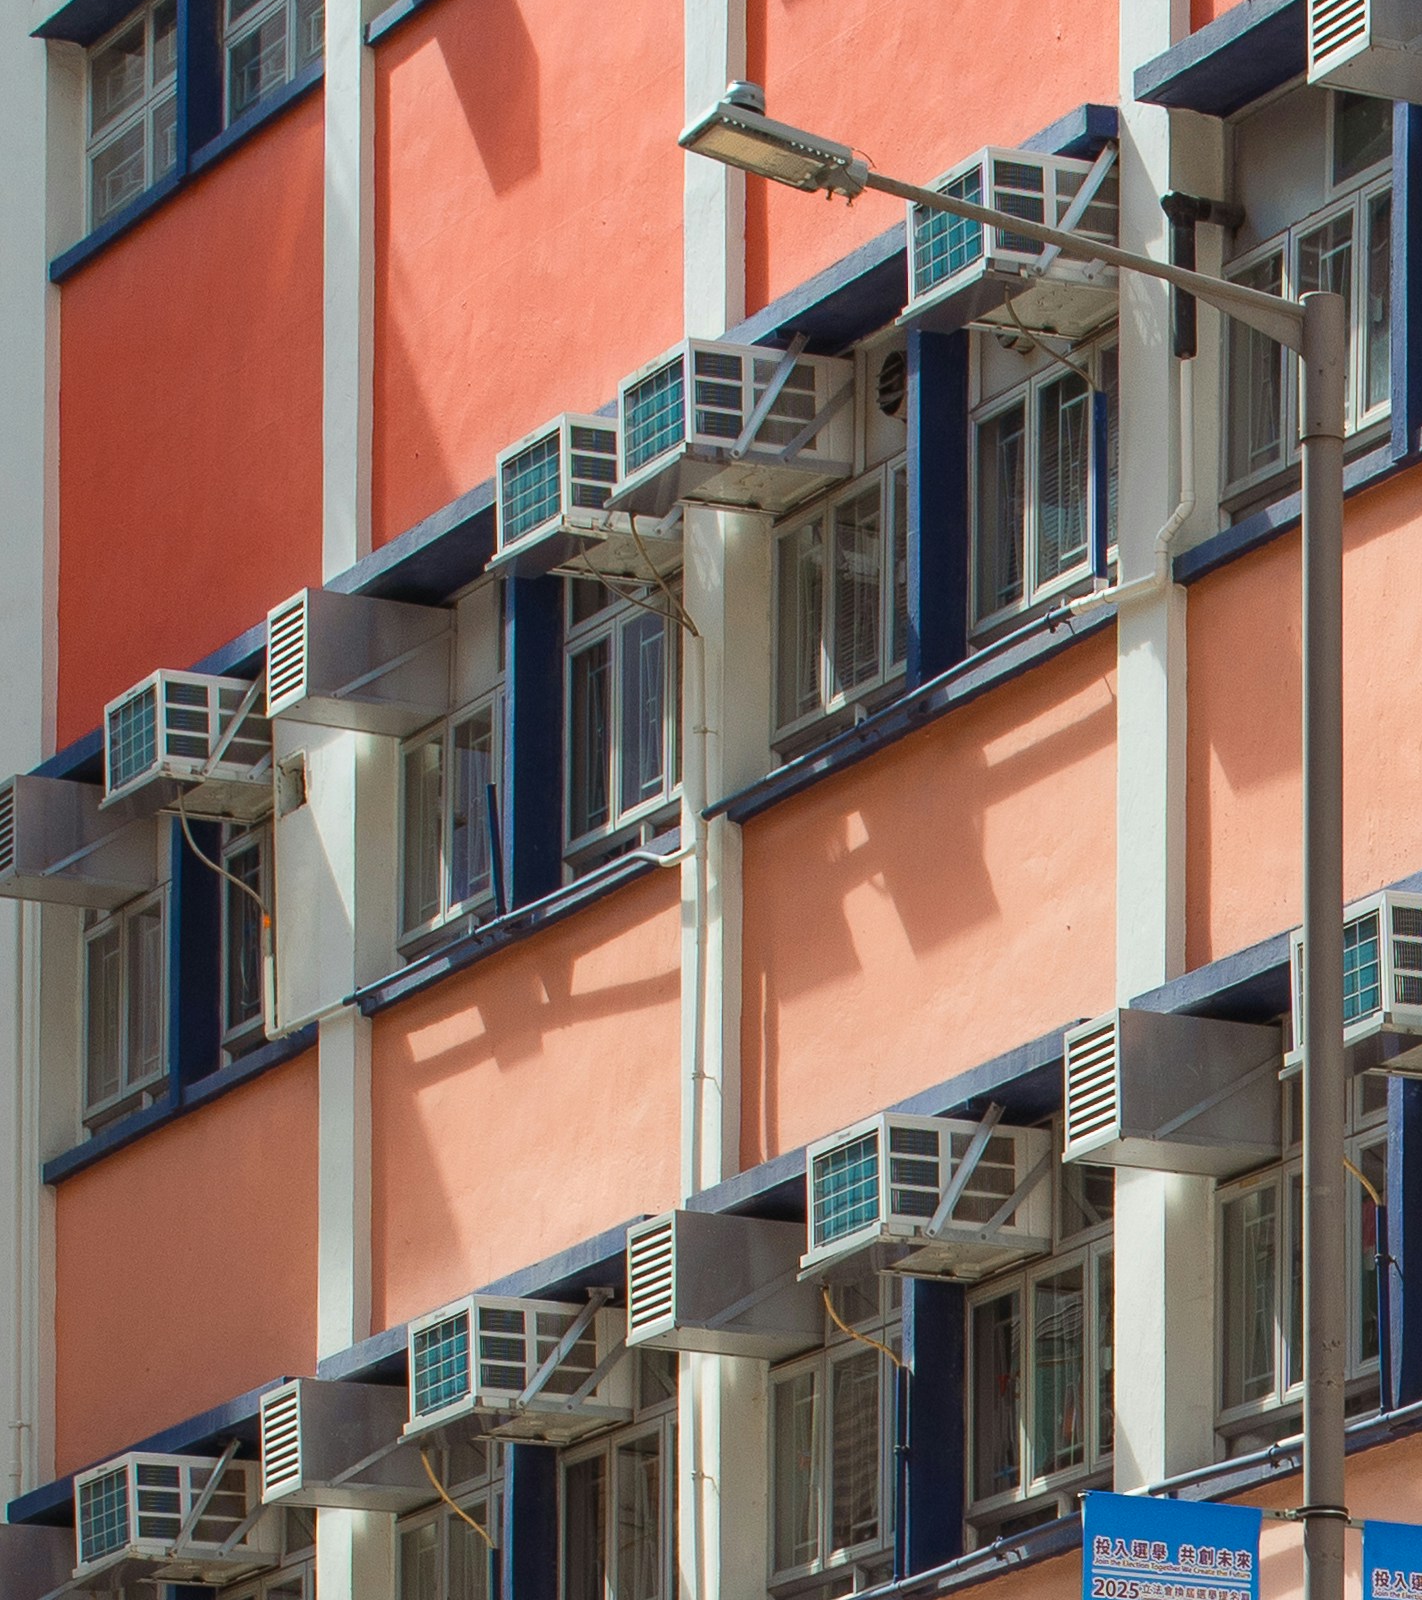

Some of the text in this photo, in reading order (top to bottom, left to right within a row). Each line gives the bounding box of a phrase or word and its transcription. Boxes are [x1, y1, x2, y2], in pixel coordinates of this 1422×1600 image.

[1094, 1536, 1252, 1571] 投入選舉 共創未來
[1092, 1578, 1140, 1600] 2025
